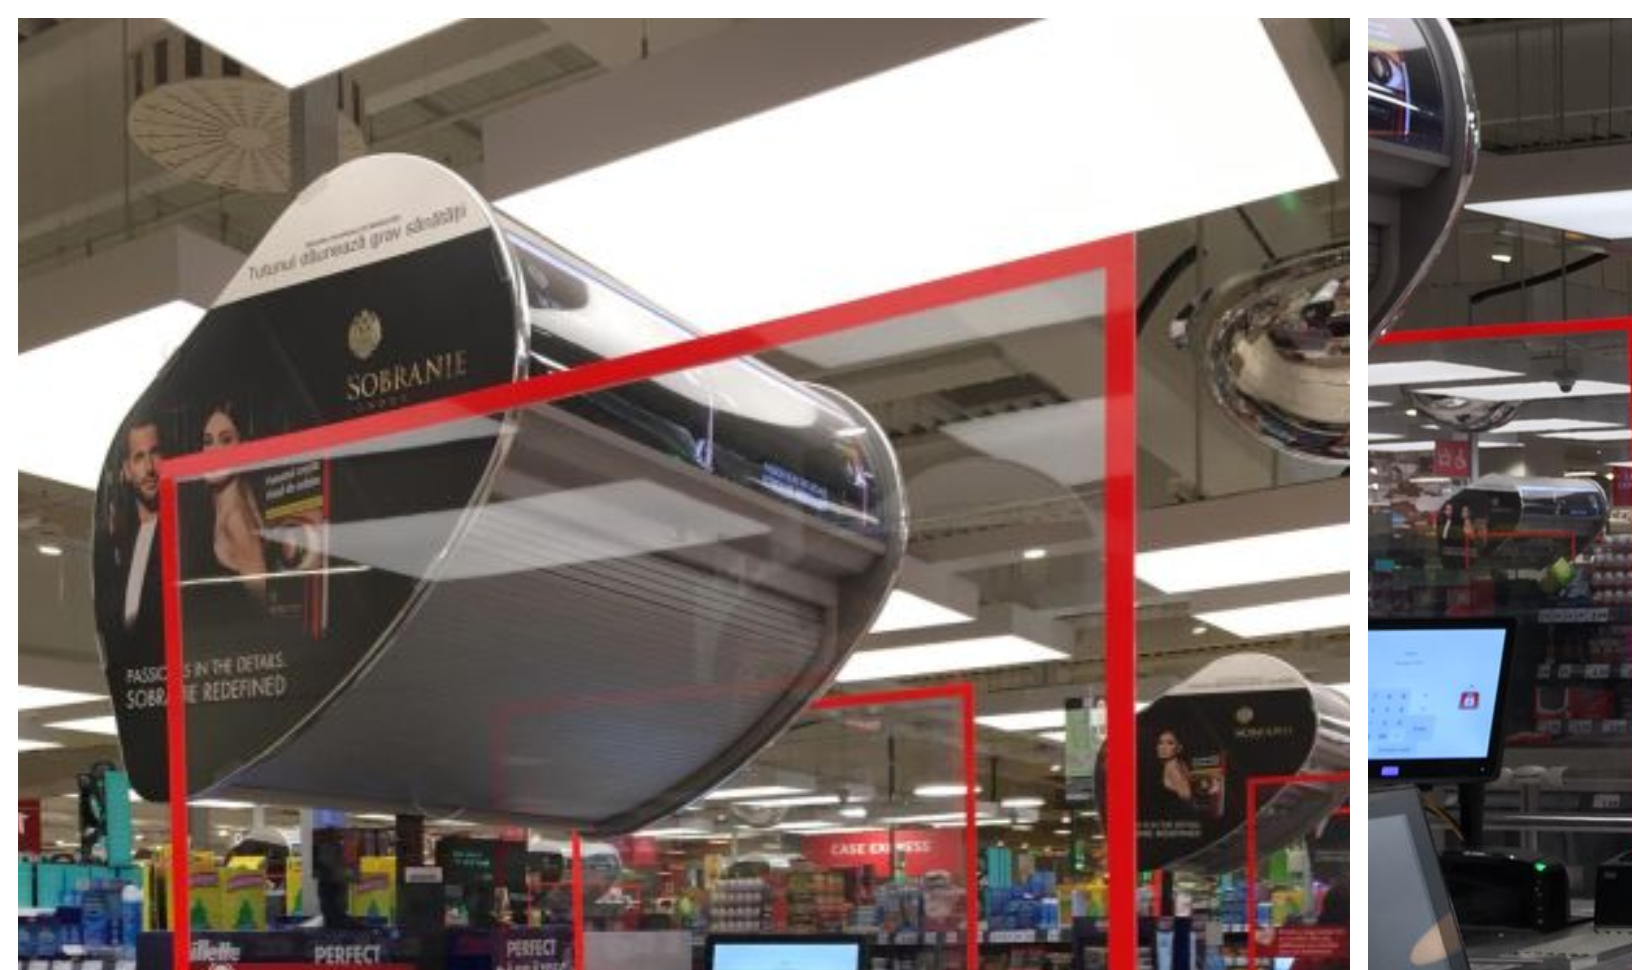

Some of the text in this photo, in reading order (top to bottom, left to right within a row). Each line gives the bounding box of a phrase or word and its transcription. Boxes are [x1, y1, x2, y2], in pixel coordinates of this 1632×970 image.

[347, 350, 468, 401] SOBRANIE
[203, 675, 286, 702] REDEFINED
[314, 944, 381, 964] PERFECT
[506, 938, 557, 957] PERFECT
